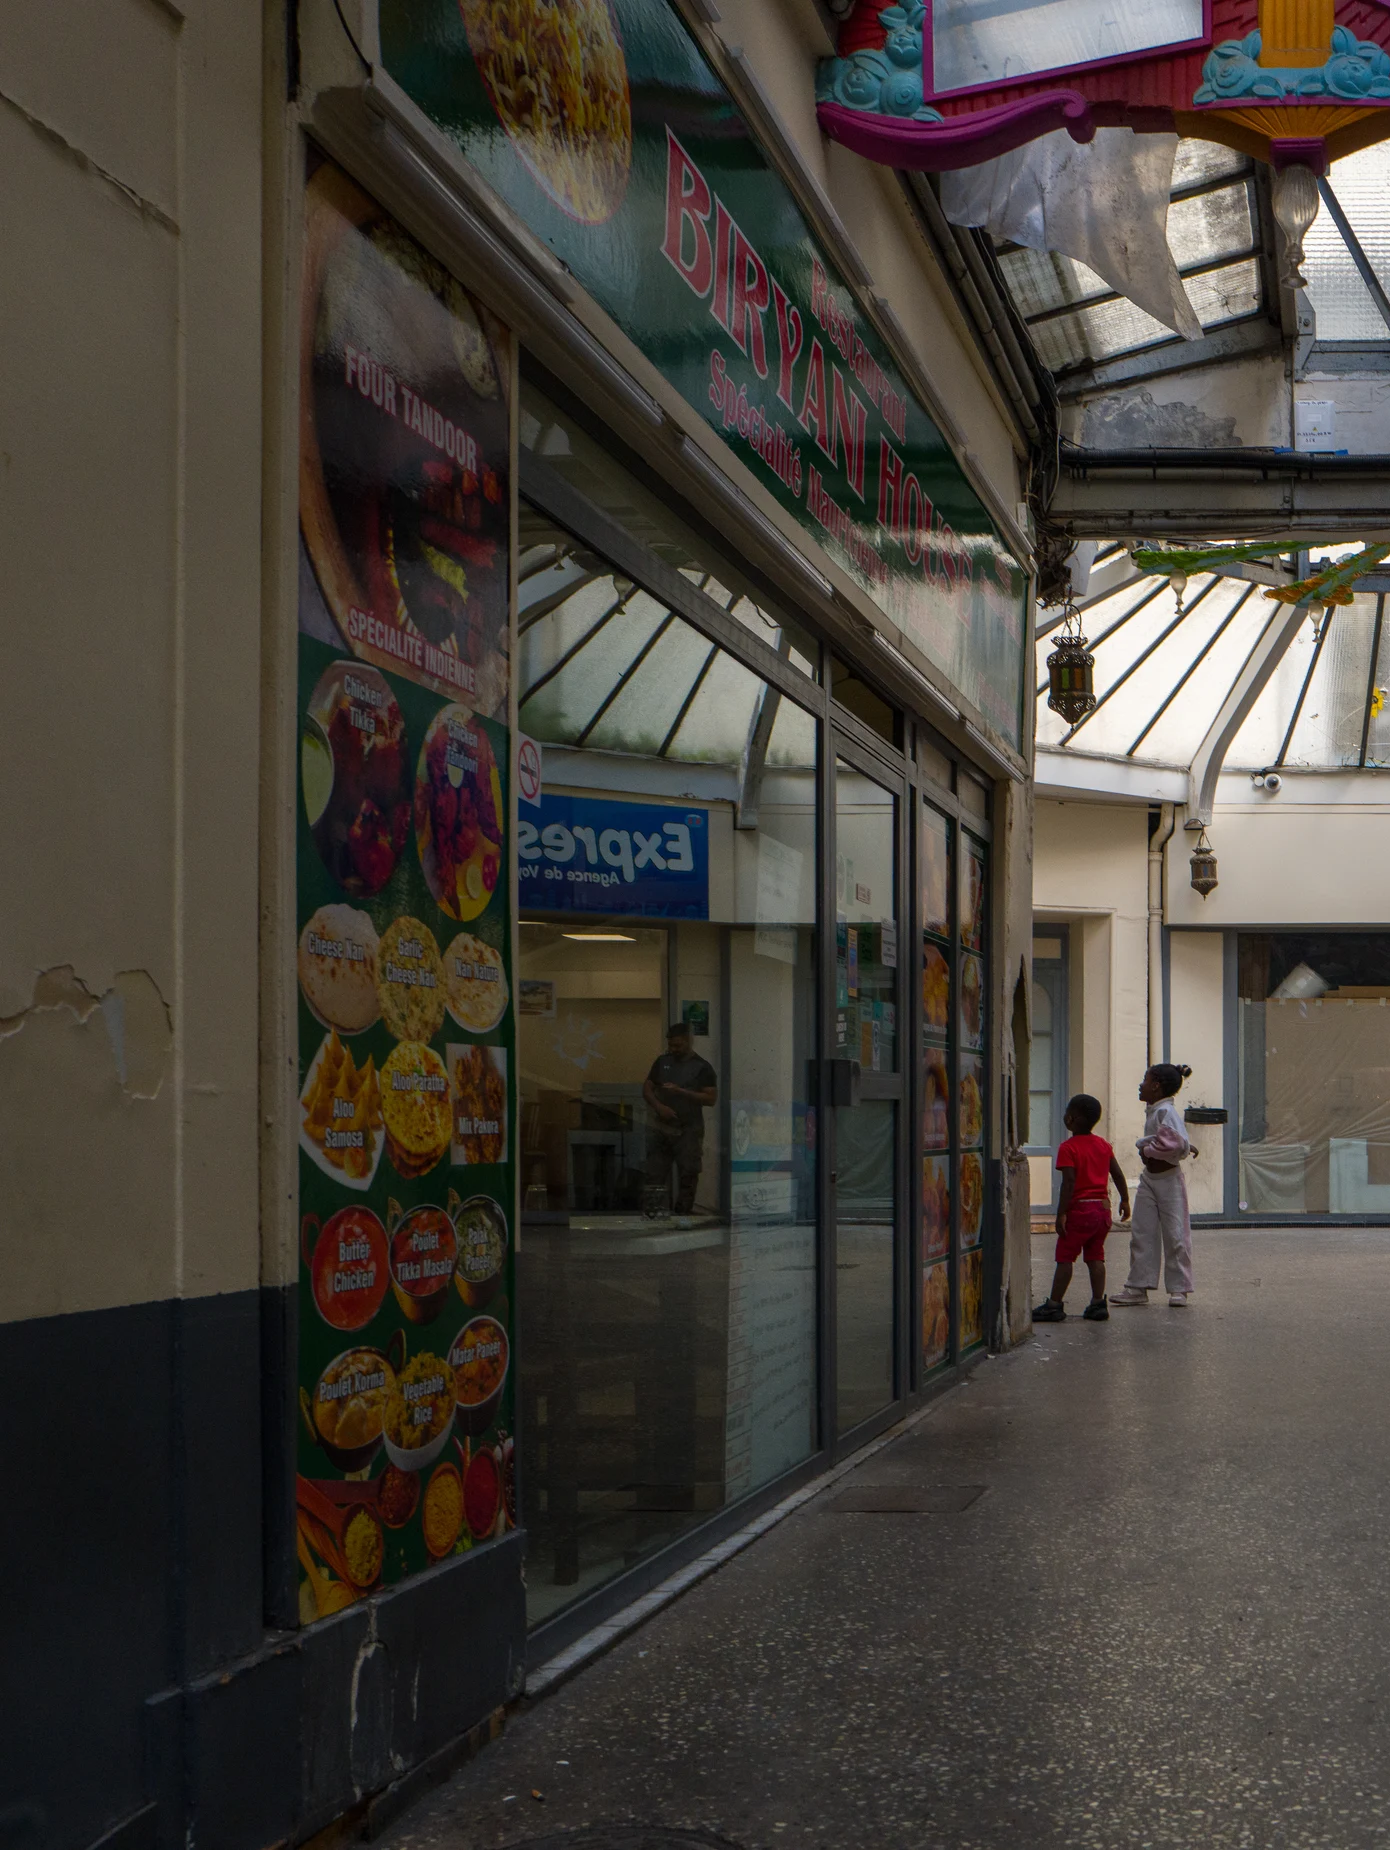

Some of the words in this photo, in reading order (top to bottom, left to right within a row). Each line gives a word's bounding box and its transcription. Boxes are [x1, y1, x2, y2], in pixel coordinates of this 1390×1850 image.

[811, 255, 908, 448] Restaurant
[662, 123, 868, 504] BIRYANI
[877, 434, 974, 630] HOUSE
[344, 345, 398, 415] FOUR
[400, 385, 478, 475] TANDOOR
[708, 348, 802, 499] Spécialité
[349, 609, 423, 668] SPÉCIALITÉ
[425, 643, 476, 694] INDIENNE
[344, 674, 383, 707] Chicken
[350, 705, 376, 733] Tikka
[308, 932, 342, 958] Cheese
[345, 937, 364, 961] Nan
[398, 937, 423, 959] Garlic
[385, 961, 416, 984] Cheese
[418, 966, 436, 987] Nan
[455, 958, 472, 978] Nan
[473, 961, 500, 982] Nature
[392, 1071, 411, 1090] Aloo
[413, 1073, 445, 1092] Paratha
[333, 1098, 355, 1118] Aloo
[325, 1127, 364, 1148] Samosa
[458, 1117, 473, 1134] Mix
[473, 1118, 499, 1135] Pakora
[339, 1241, 370, 1262] Butter
[412, 1230, 439, 1252] Poulet
[334, 1270, 374, 1293] Chicken
[396, 1261, 421, 1282] Tikka
[423, 1257, 453, 1278] Masala
[476, 1340, 501, 1359] Paneer
[320, 1375, 353, 1402] Poulet
[354, 1370, 385, 1393] Korma
[403, 1374, 444, 1402] Vegetable
[413, 1406, 432, 1426] Rice
